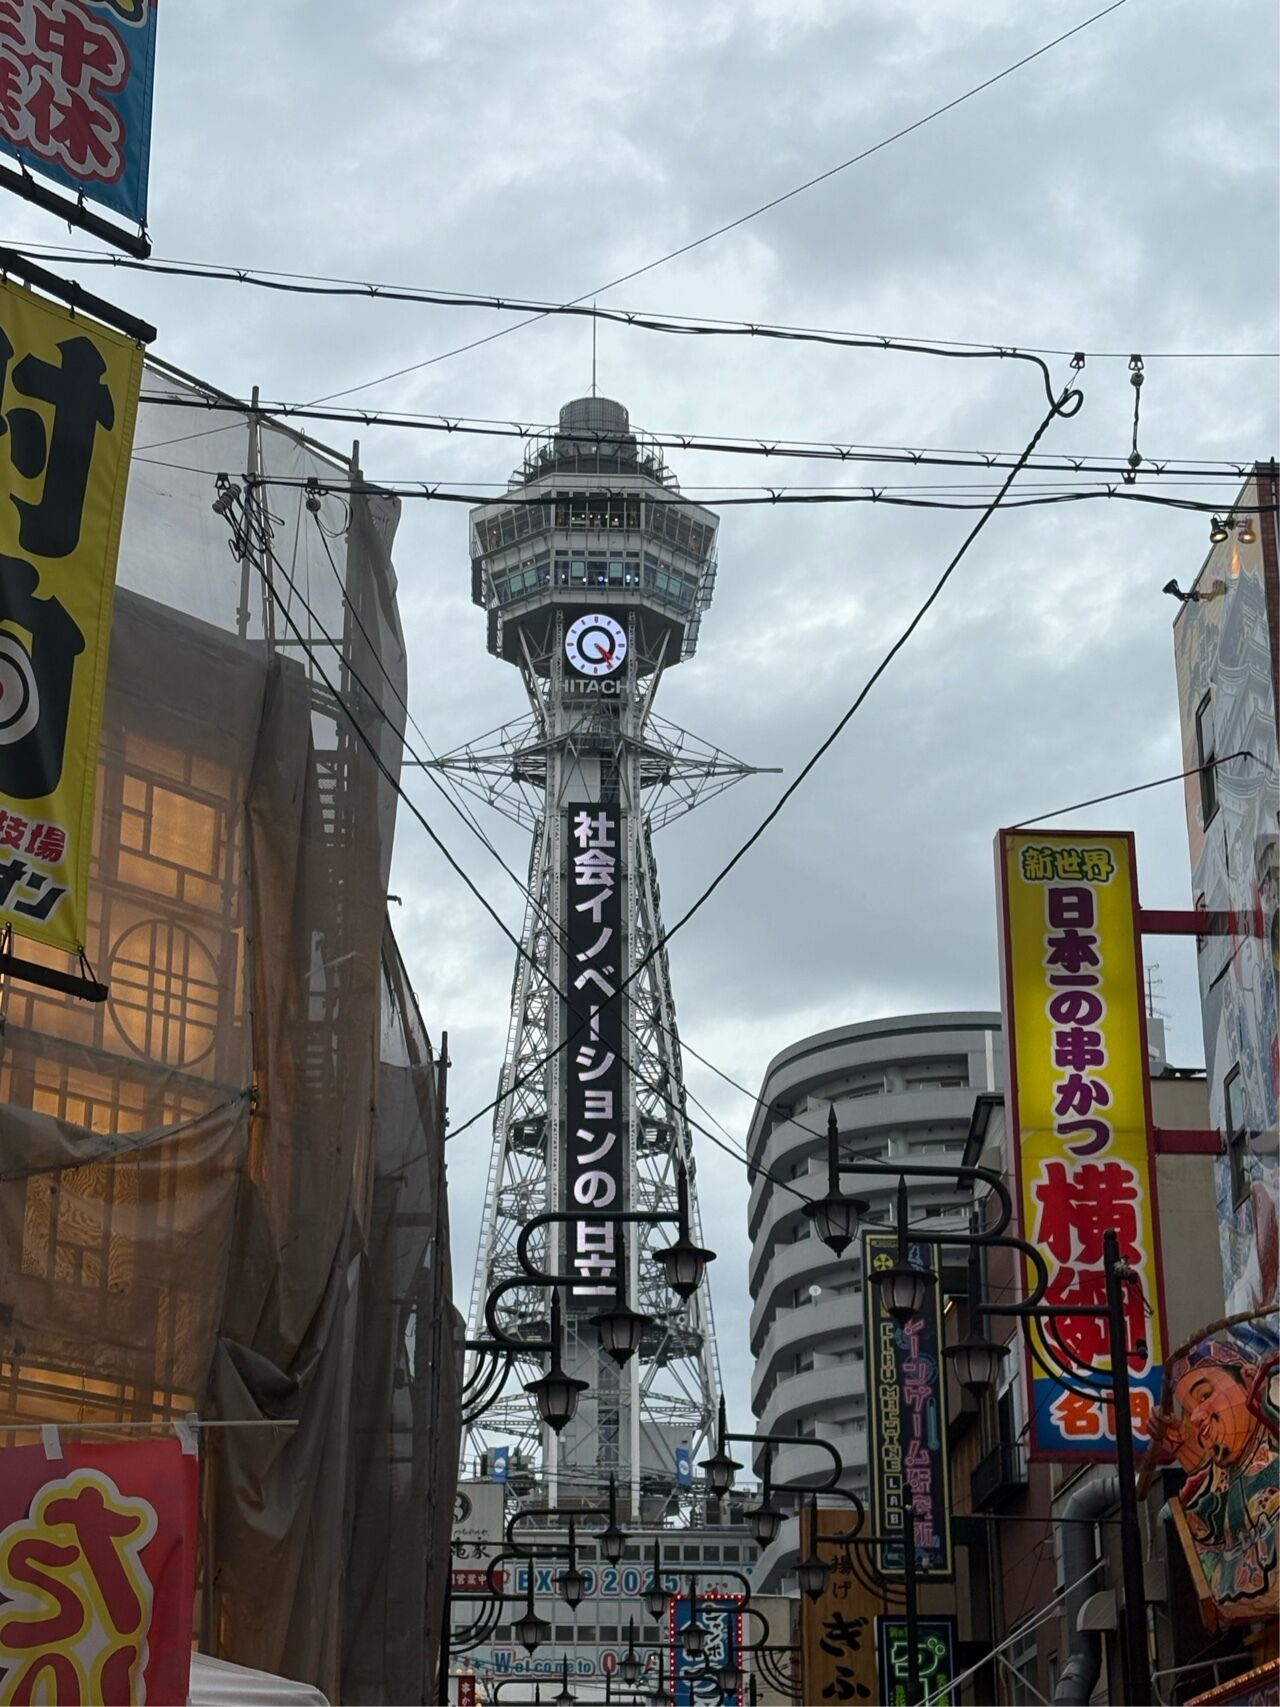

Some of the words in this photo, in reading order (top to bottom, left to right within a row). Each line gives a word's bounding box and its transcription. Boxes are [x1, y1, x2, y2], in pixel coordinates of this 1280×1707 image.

[1022, 845, 1115, 883] 新世界
[1047, 887, 1110, 1154] 日本一の串かつ
[886, 1475, 901, 1527] LAB
[494, 1651, 574, 1673] Welcome
[578, 1655, 592, 1673] to
[819, 1611, 872, 1700] ぎふ
